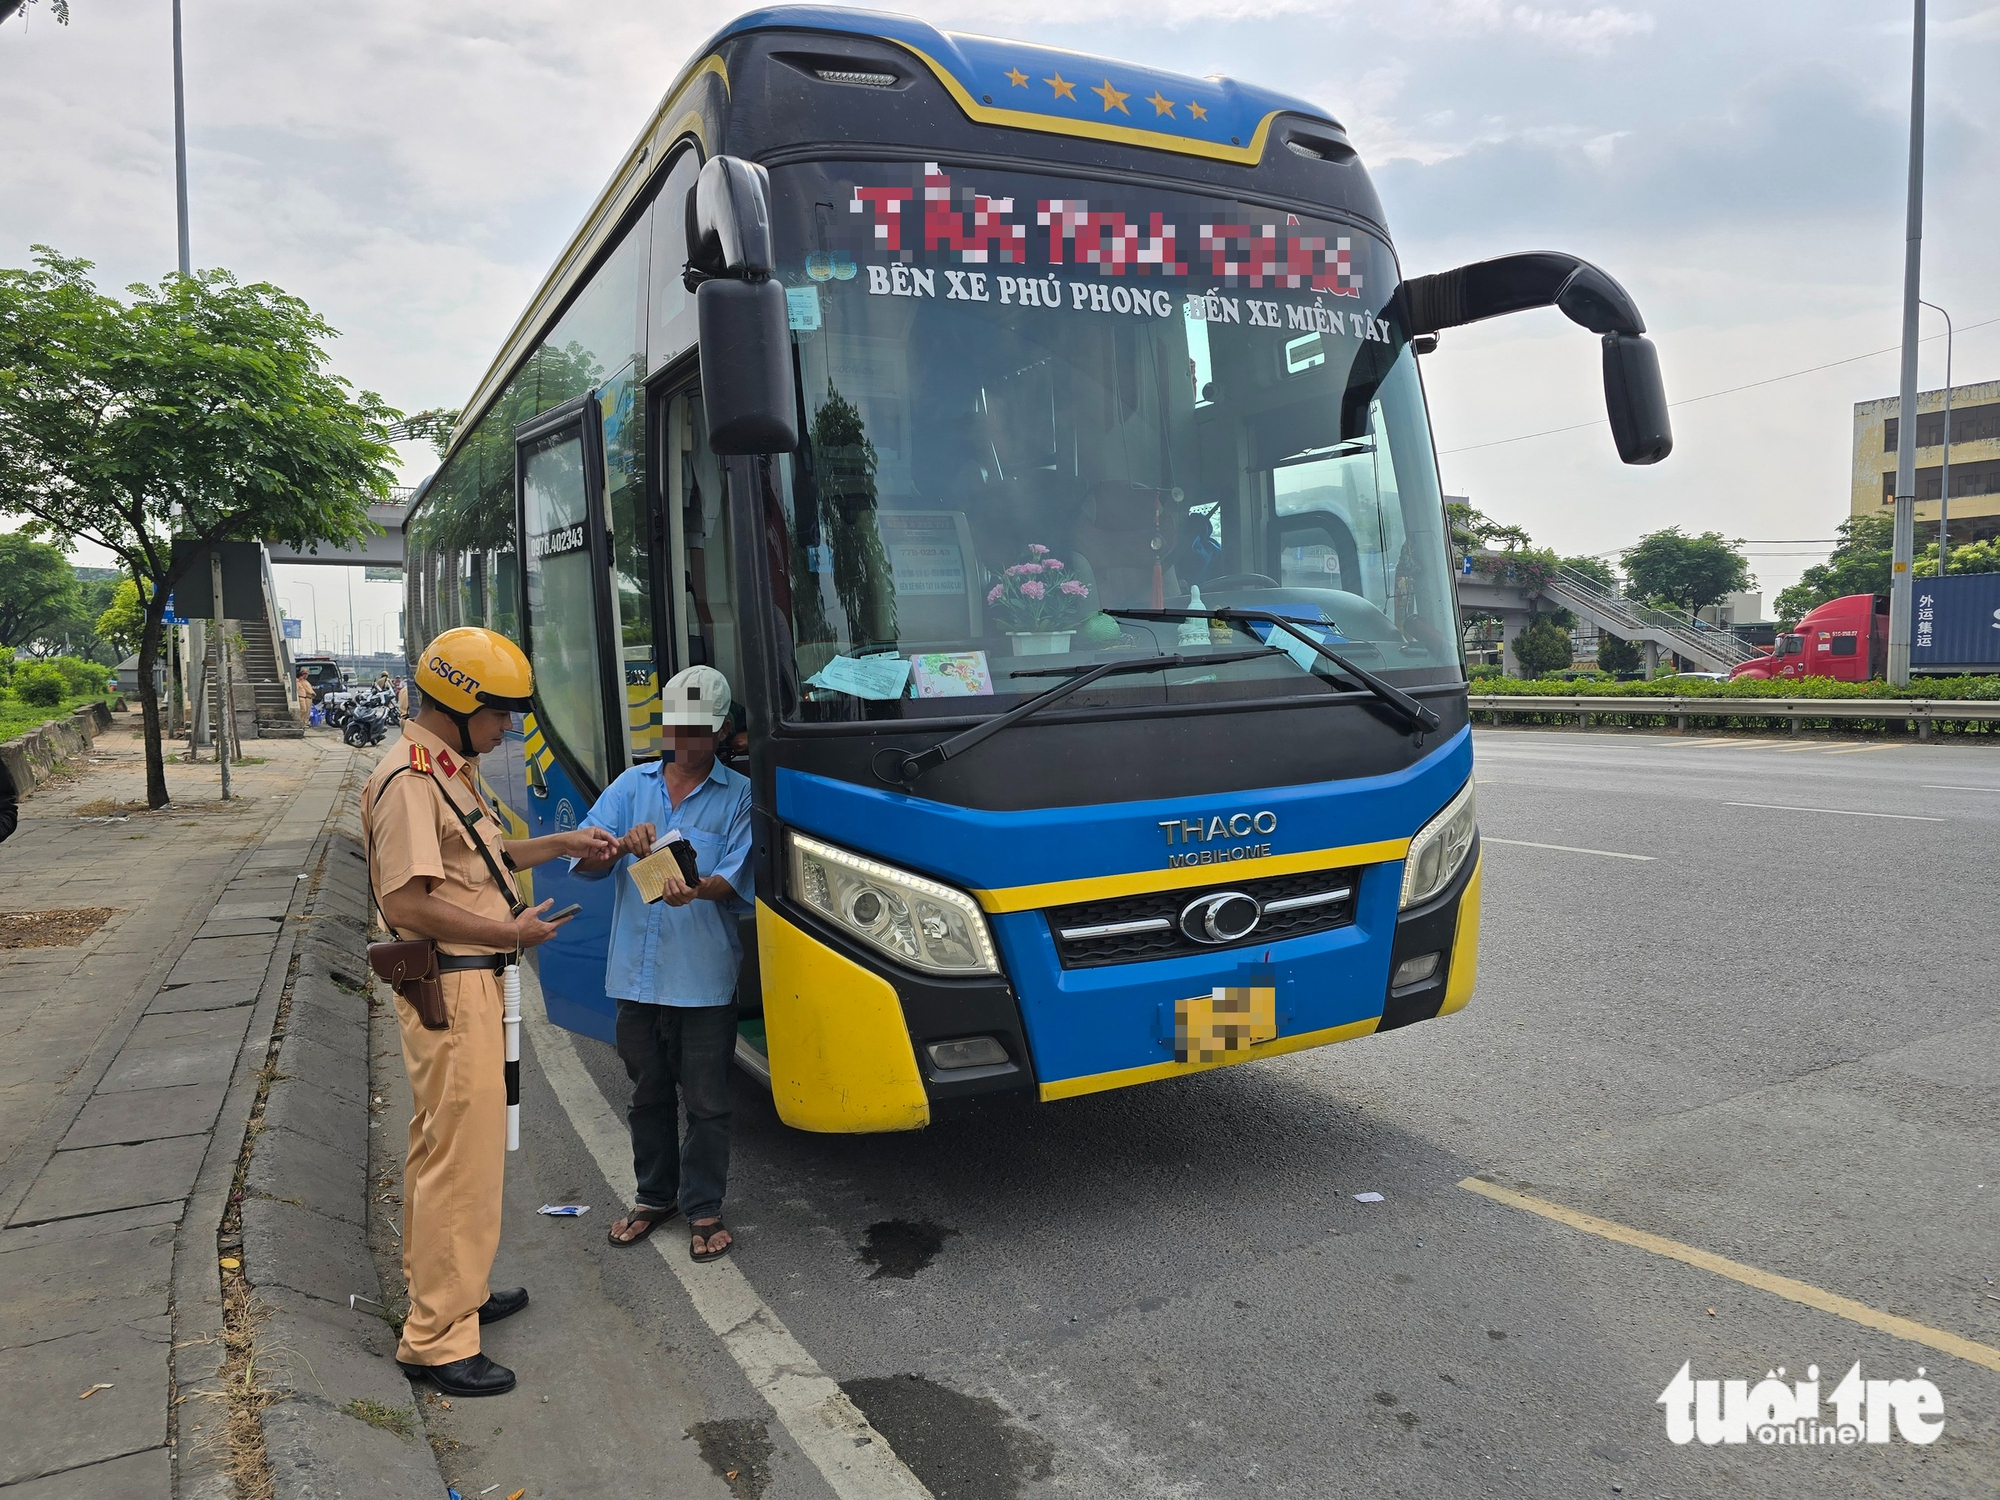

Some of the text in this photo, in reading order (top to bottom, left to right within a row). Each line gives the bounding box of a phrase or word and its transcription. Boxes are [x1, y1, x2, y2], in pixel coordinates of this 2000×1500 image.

[944, 270, 990, 302] XE
[996, 272, 1062, 308] PHÚ
[1069, 282, 1173, 318] PHONG
[1186, 286, 1241, 324] BẾN
[1246, 299, 1282, 328] XE
[1285, 296, 1346, 336] MIỀN
[1349, 308, 1391, 344] TÂY
[530, 526, 584, 557] 0976.402343
[900, 548, 951, 556] 77B-023.43
[1917, 594, 1934, 647] 外运集运
[429, 656, 480, 694] CSGT
[1158, 810, 1277, 846] THACO
[1168, 842, 1272, 869] MOBIHOME
